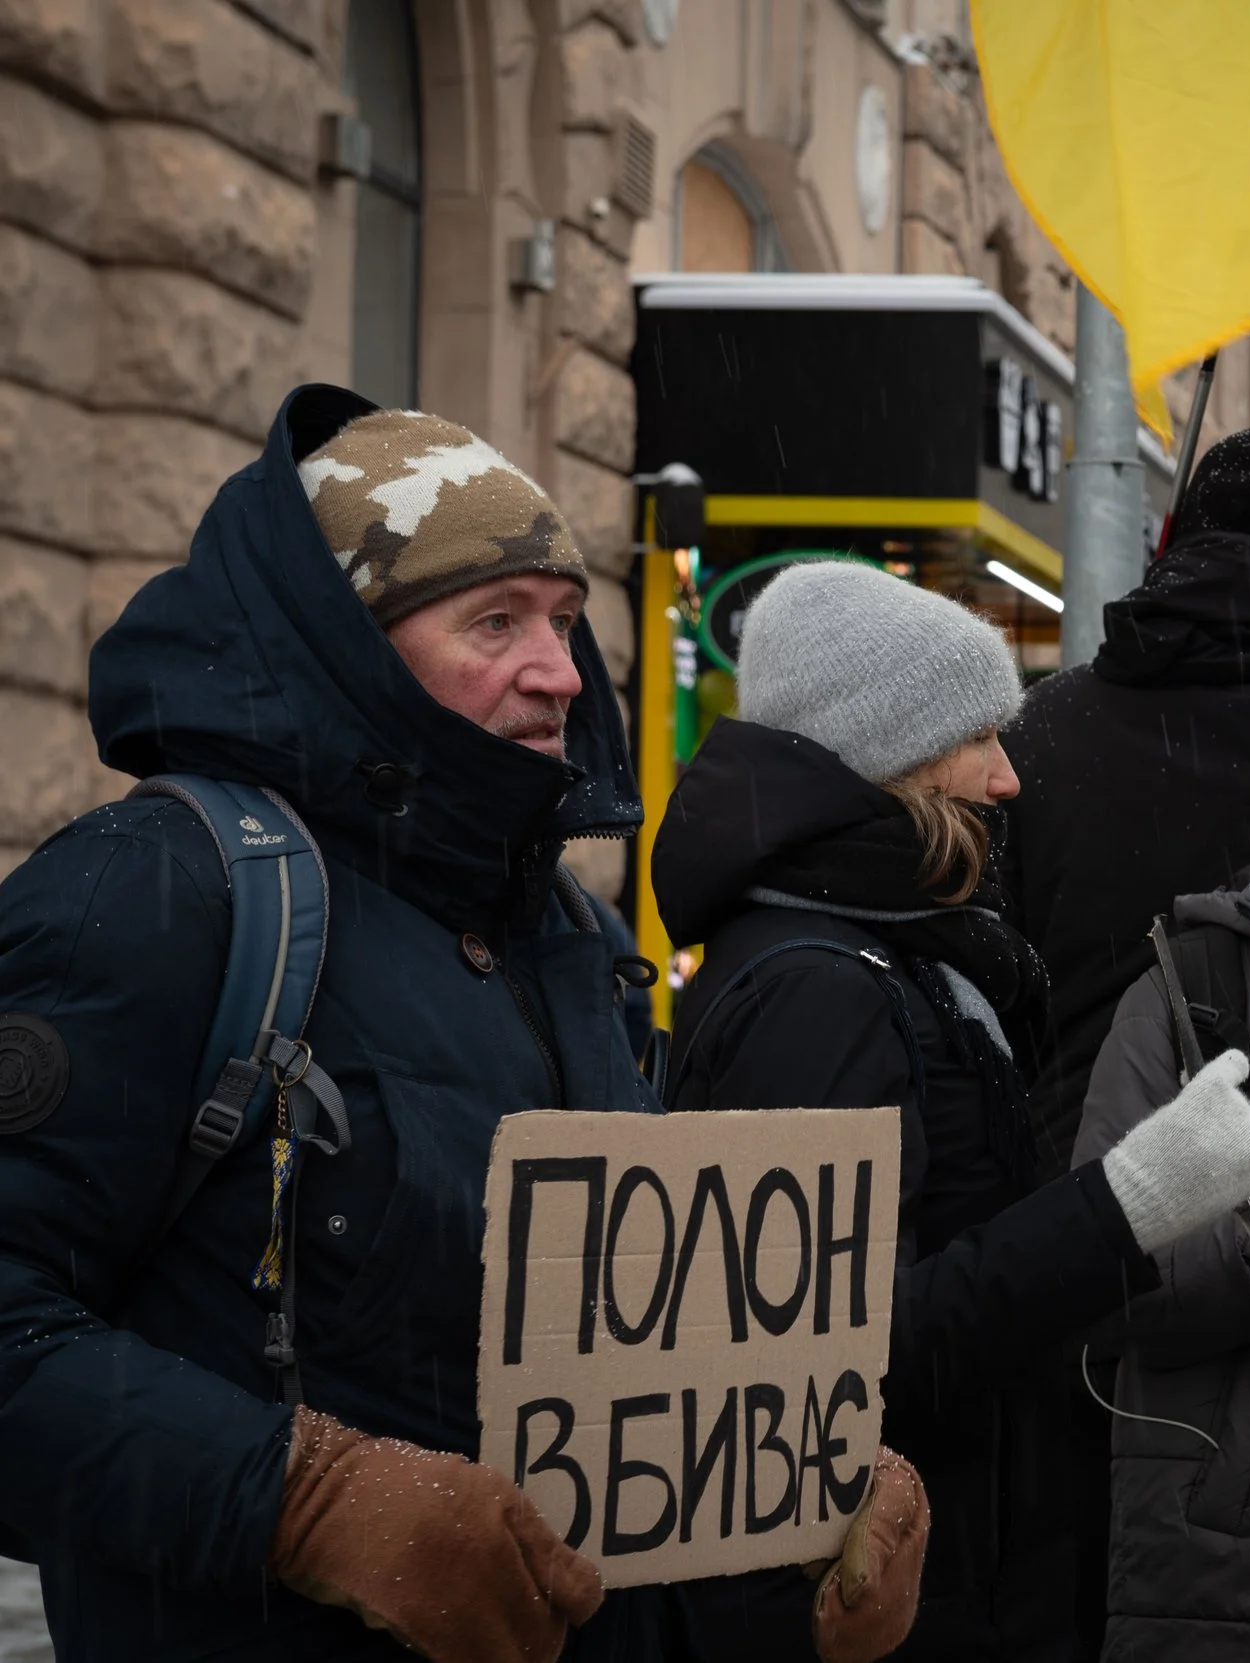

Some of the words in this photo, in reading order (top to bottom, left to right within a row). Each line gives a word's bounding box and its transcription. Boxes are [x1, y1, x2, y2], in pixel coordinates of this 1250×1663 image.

[242, 834, 287, 845] deuter
[502, 1156, 873, 1366] ПОЛОН
[513, 1369, 871, 1557] ВБИВАЄ
